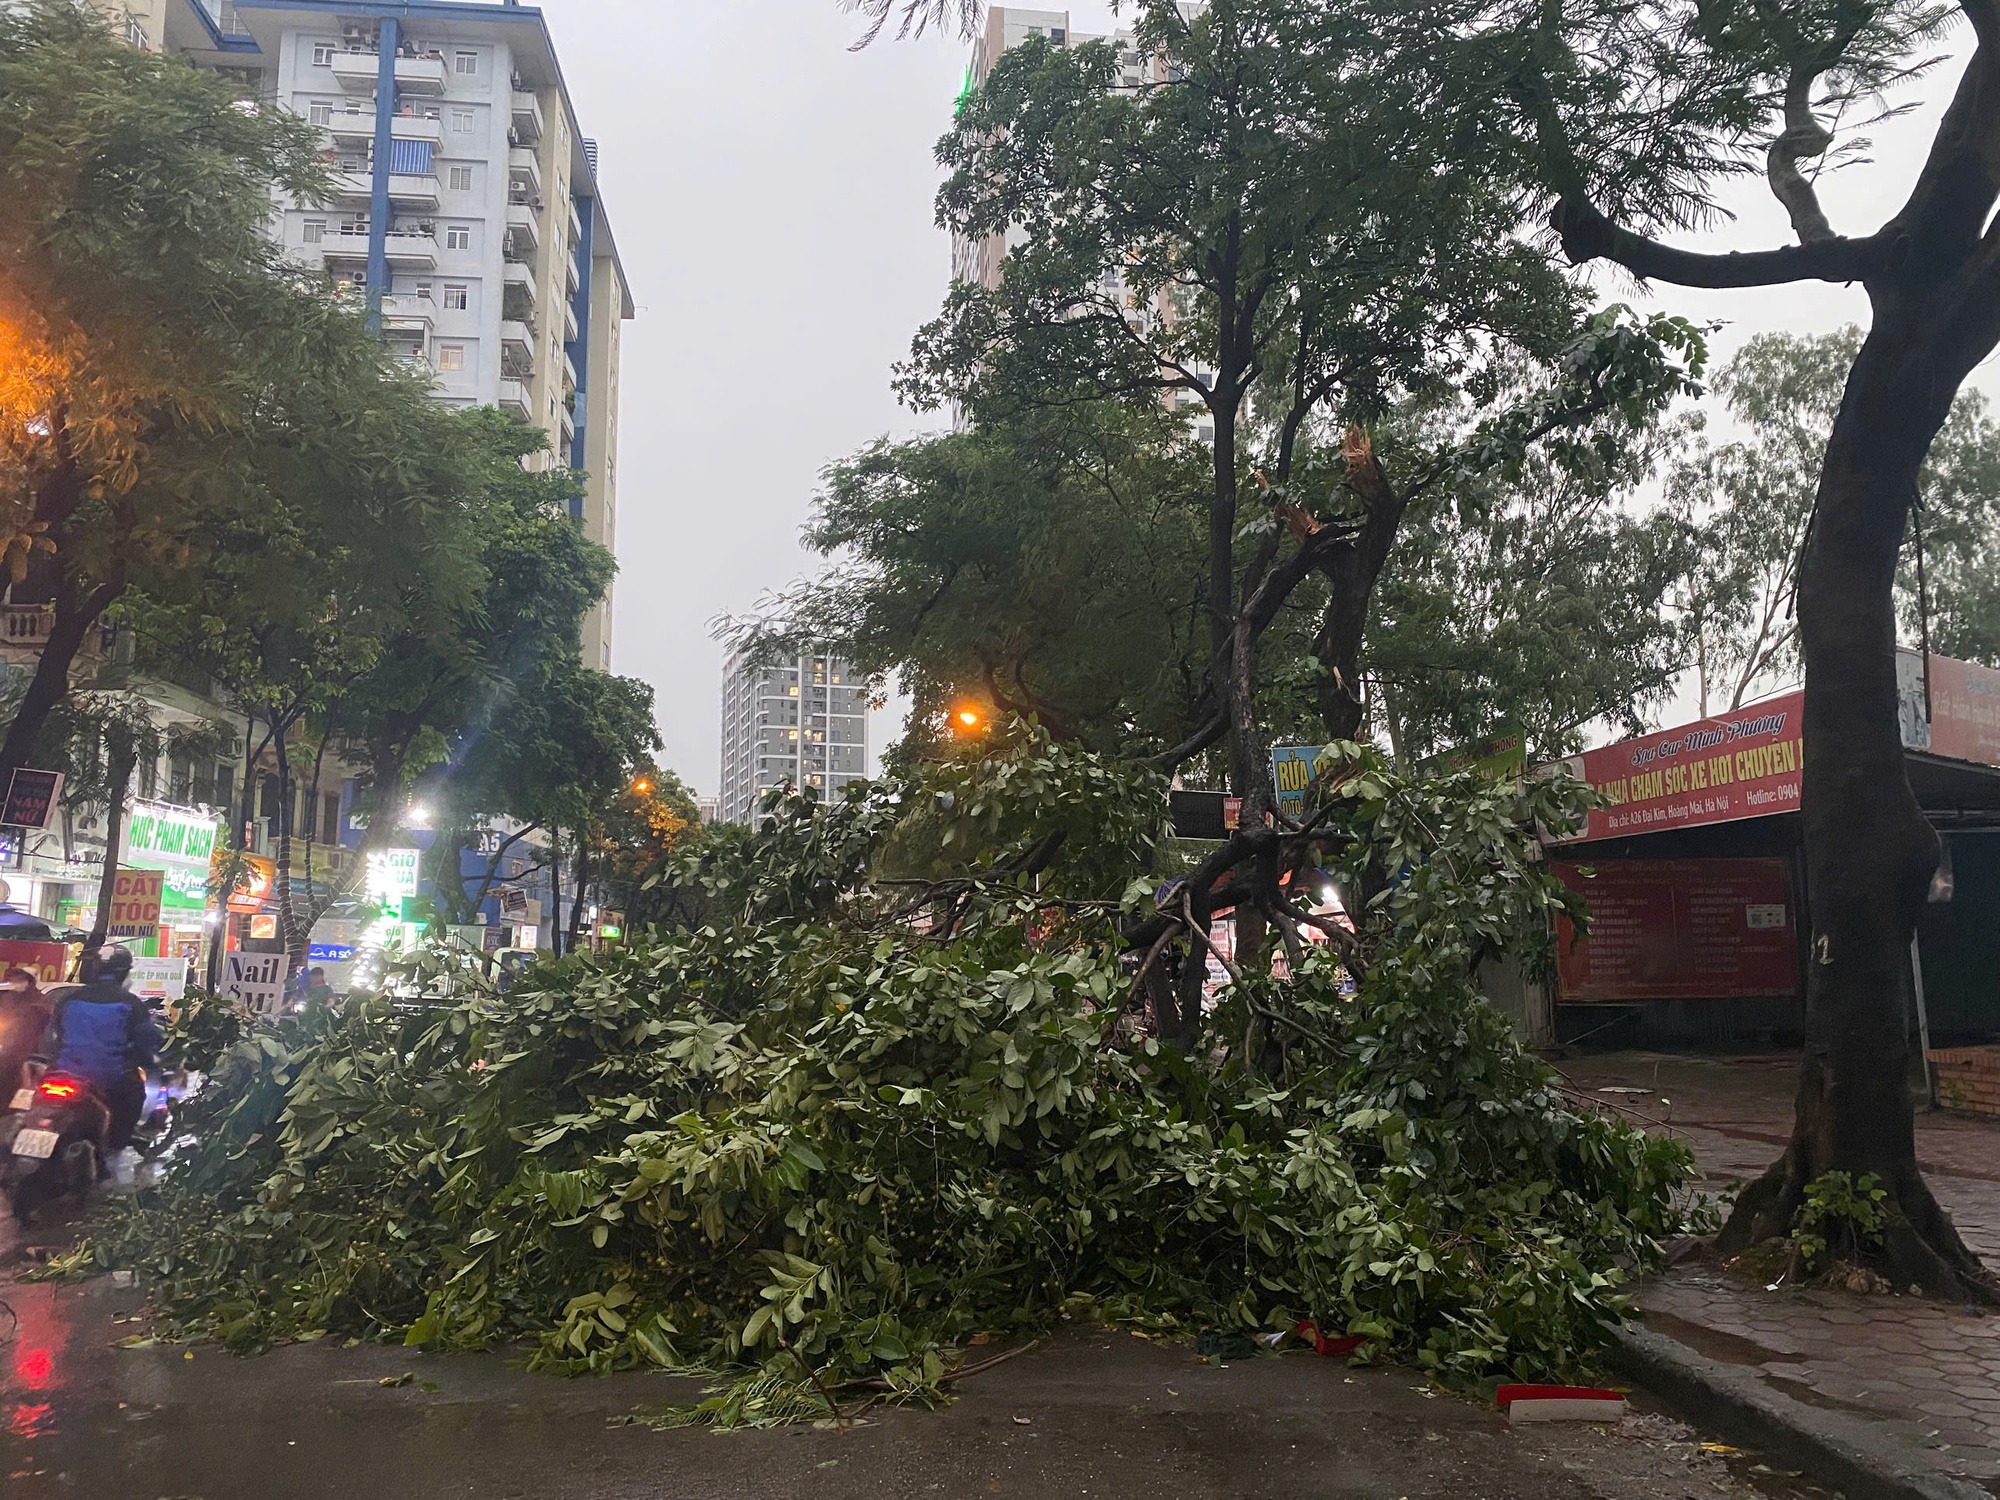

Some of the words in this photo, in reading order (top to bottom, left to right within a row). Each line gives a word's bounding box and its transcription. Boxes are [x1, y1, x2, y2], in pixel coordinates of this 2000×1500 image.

[1631, 746, 1655, 767] Spa
[1657, 740, 1682, 759] Car
[1684, 725, 1724, 751] Minh
[1727, 712, 1787, 743] Phương
[1278, 750, 1309, 790] RỬA
[1631, 767, 1663, 802] CHĂM
[1665, 761, 1688, 795] SÓC
[1690, 760, 1707, 790] XE
[1735, 737, 1795, 781] CHUYÊN
[1630, 811, 1641, 824] A26
[1746, 789, 1777, 806] Hotline:
[1777, 783, 1799, 801] 0904
[116, 870, 160, 896] CẮT
[113, 898, 158, 921] TÓC
[110, 925, 135, 936] NAM
[225, 957, 279, 984] Nail
